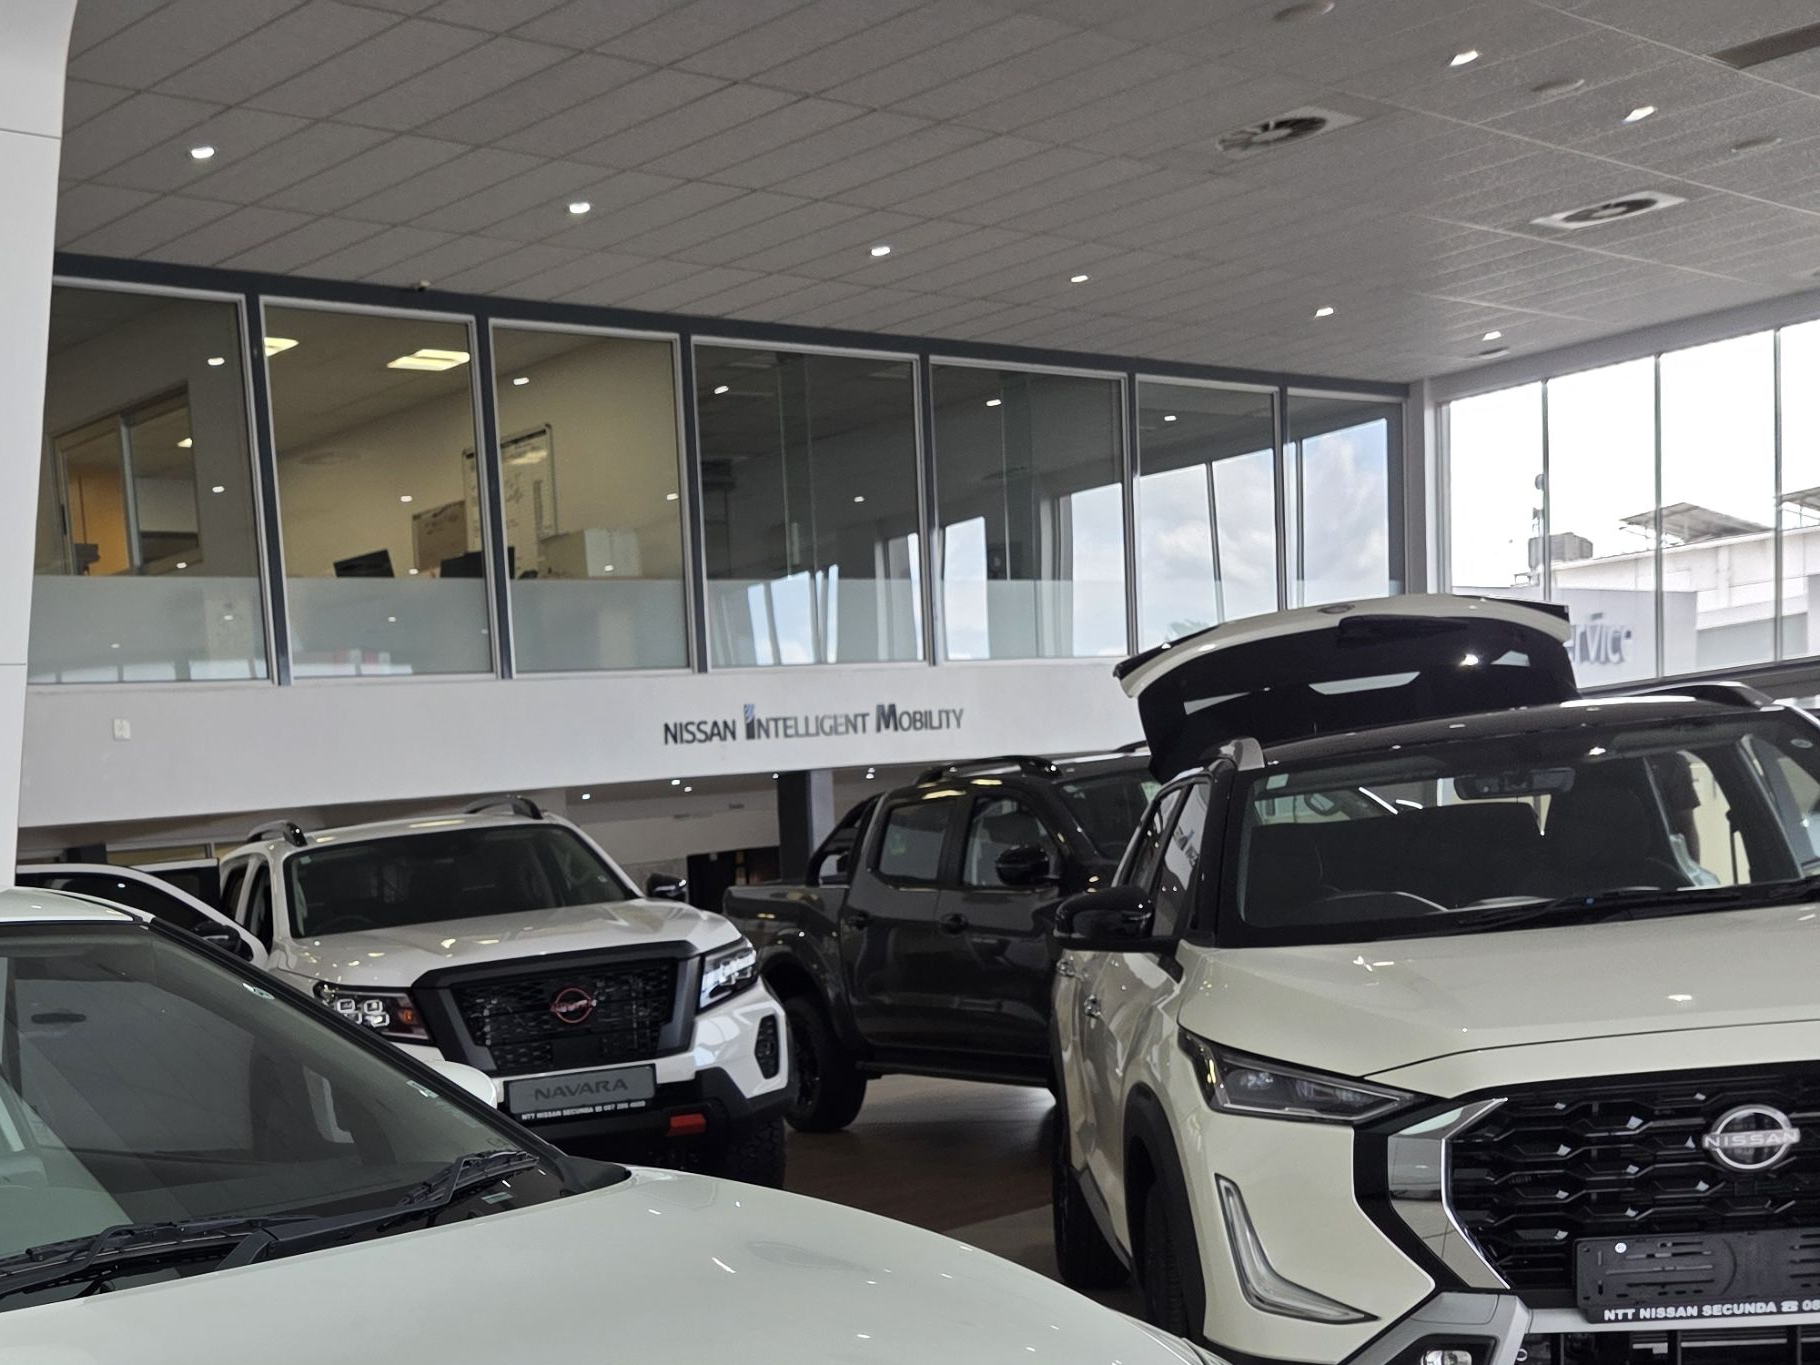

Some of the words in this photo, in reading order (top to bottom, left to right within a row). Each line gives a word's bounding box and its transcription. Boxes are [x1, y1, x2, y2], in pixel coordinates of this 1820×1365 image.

[663, 719, 737, 745] NISSAN
[743, 704, 870, 740] INTELLIGENT
[876, 703, 965, 733] MOBILITY
[534, 1078, 629, 1101] NAVARA
[1704, 1131, 1798, 1148] NISSAN
[1604, 1308, 1635, 1321] NTT
[1639, 1305, 1698, 1319] NISSAN
[1701, 1301, 1777, 1316] SECUNDA
